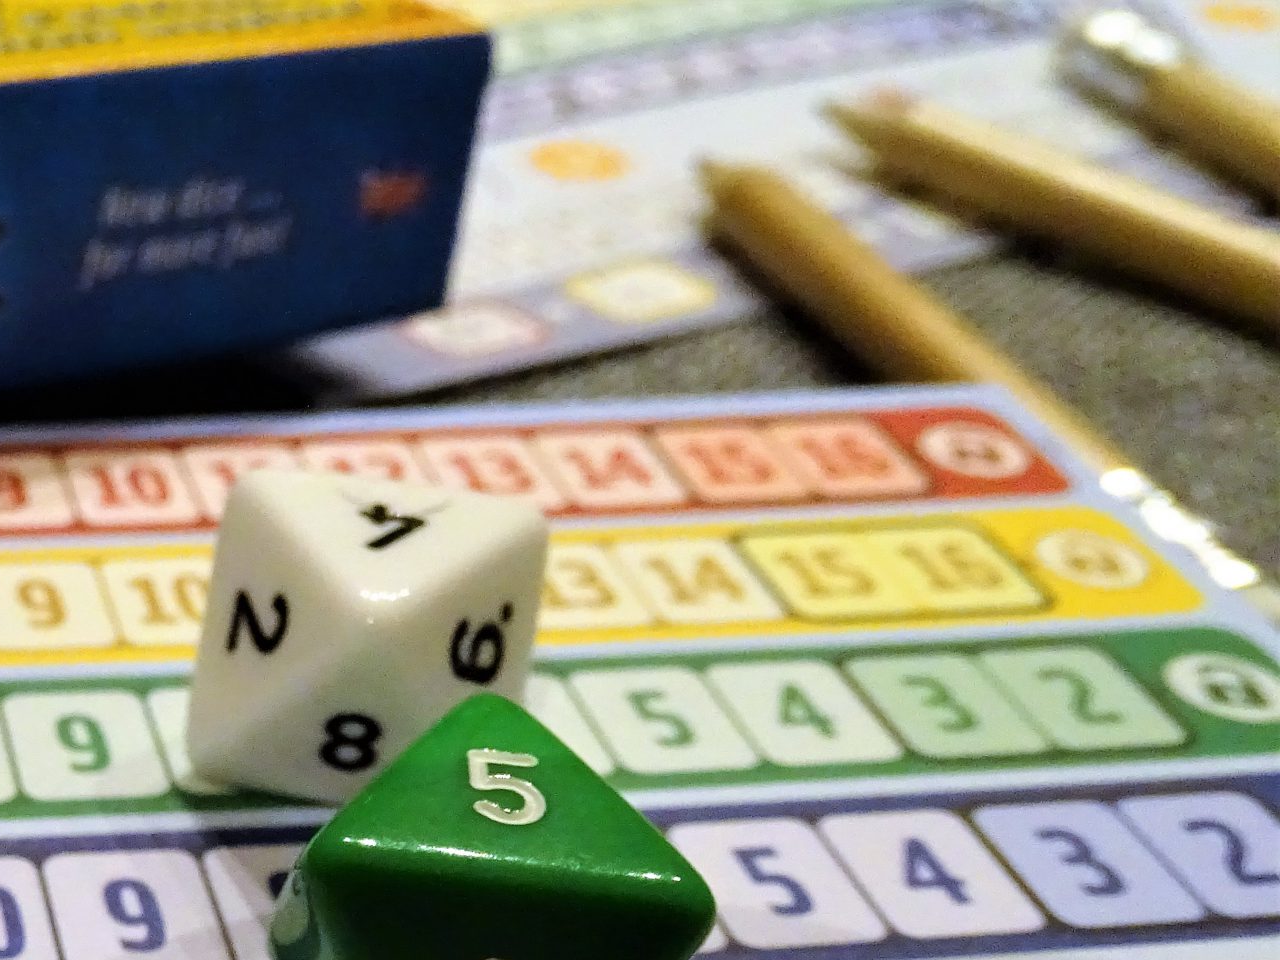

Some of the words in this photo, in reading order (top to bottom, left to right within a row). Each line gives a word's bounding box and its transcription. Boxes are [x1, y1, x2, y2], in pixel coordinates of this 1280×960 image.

[88, 464, 168, 508] 10
[564, 450, 647, 490] 14
[16, 580, 65, 629] 9
[646, 556, 728, 604] 14
[776, 552, 872, 599] 15
[914, 547, 1002, 594] 16
[227, 590, 290, 654] 2
[56, 713, 111, 773] 9
[630, 692, 693, 746] 5
[776, 685, 831, 737] 4
[906, 676, 974, 732] 3
[1048, 670, 1118, 724] 2
[319, 712, 382, 771] 8
[466, 748, 548, 825] 5
[105, 879, 165, 951] 9
[733, 847, 811, 915] 5
[902, 838, 969, 905] 4
[1039, 829, 1122, 895] 3
[1185, 819, 1280, 887] 2
